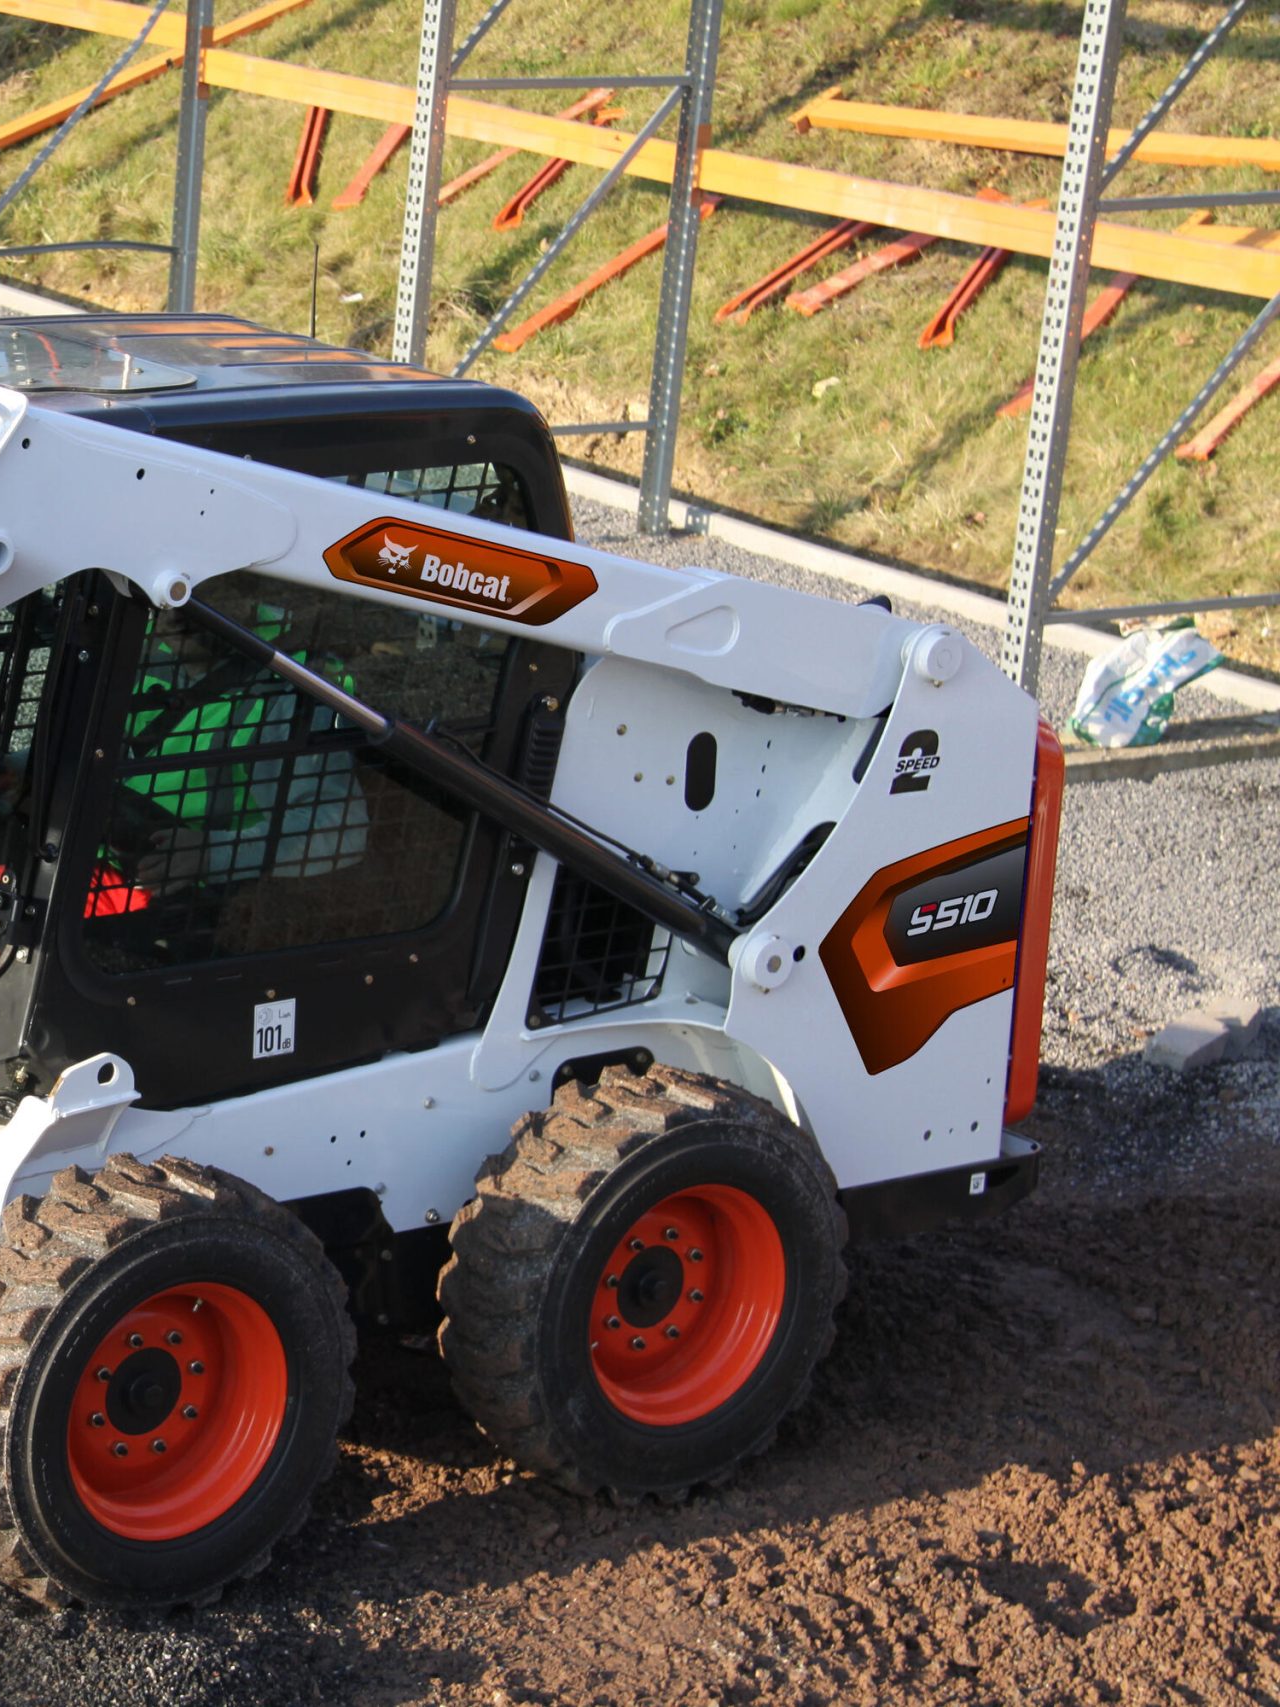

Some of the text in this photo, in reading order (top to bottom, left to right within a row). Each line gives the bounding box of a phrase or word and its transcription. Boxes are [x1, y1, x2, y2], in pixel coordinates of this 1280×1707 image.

[420, 553, 510, 602] Bobcat
[895, 756, 941, 773] SPEED
[906, 888, 999, 937] S510
[256, 1024, 282, 1054] 101
